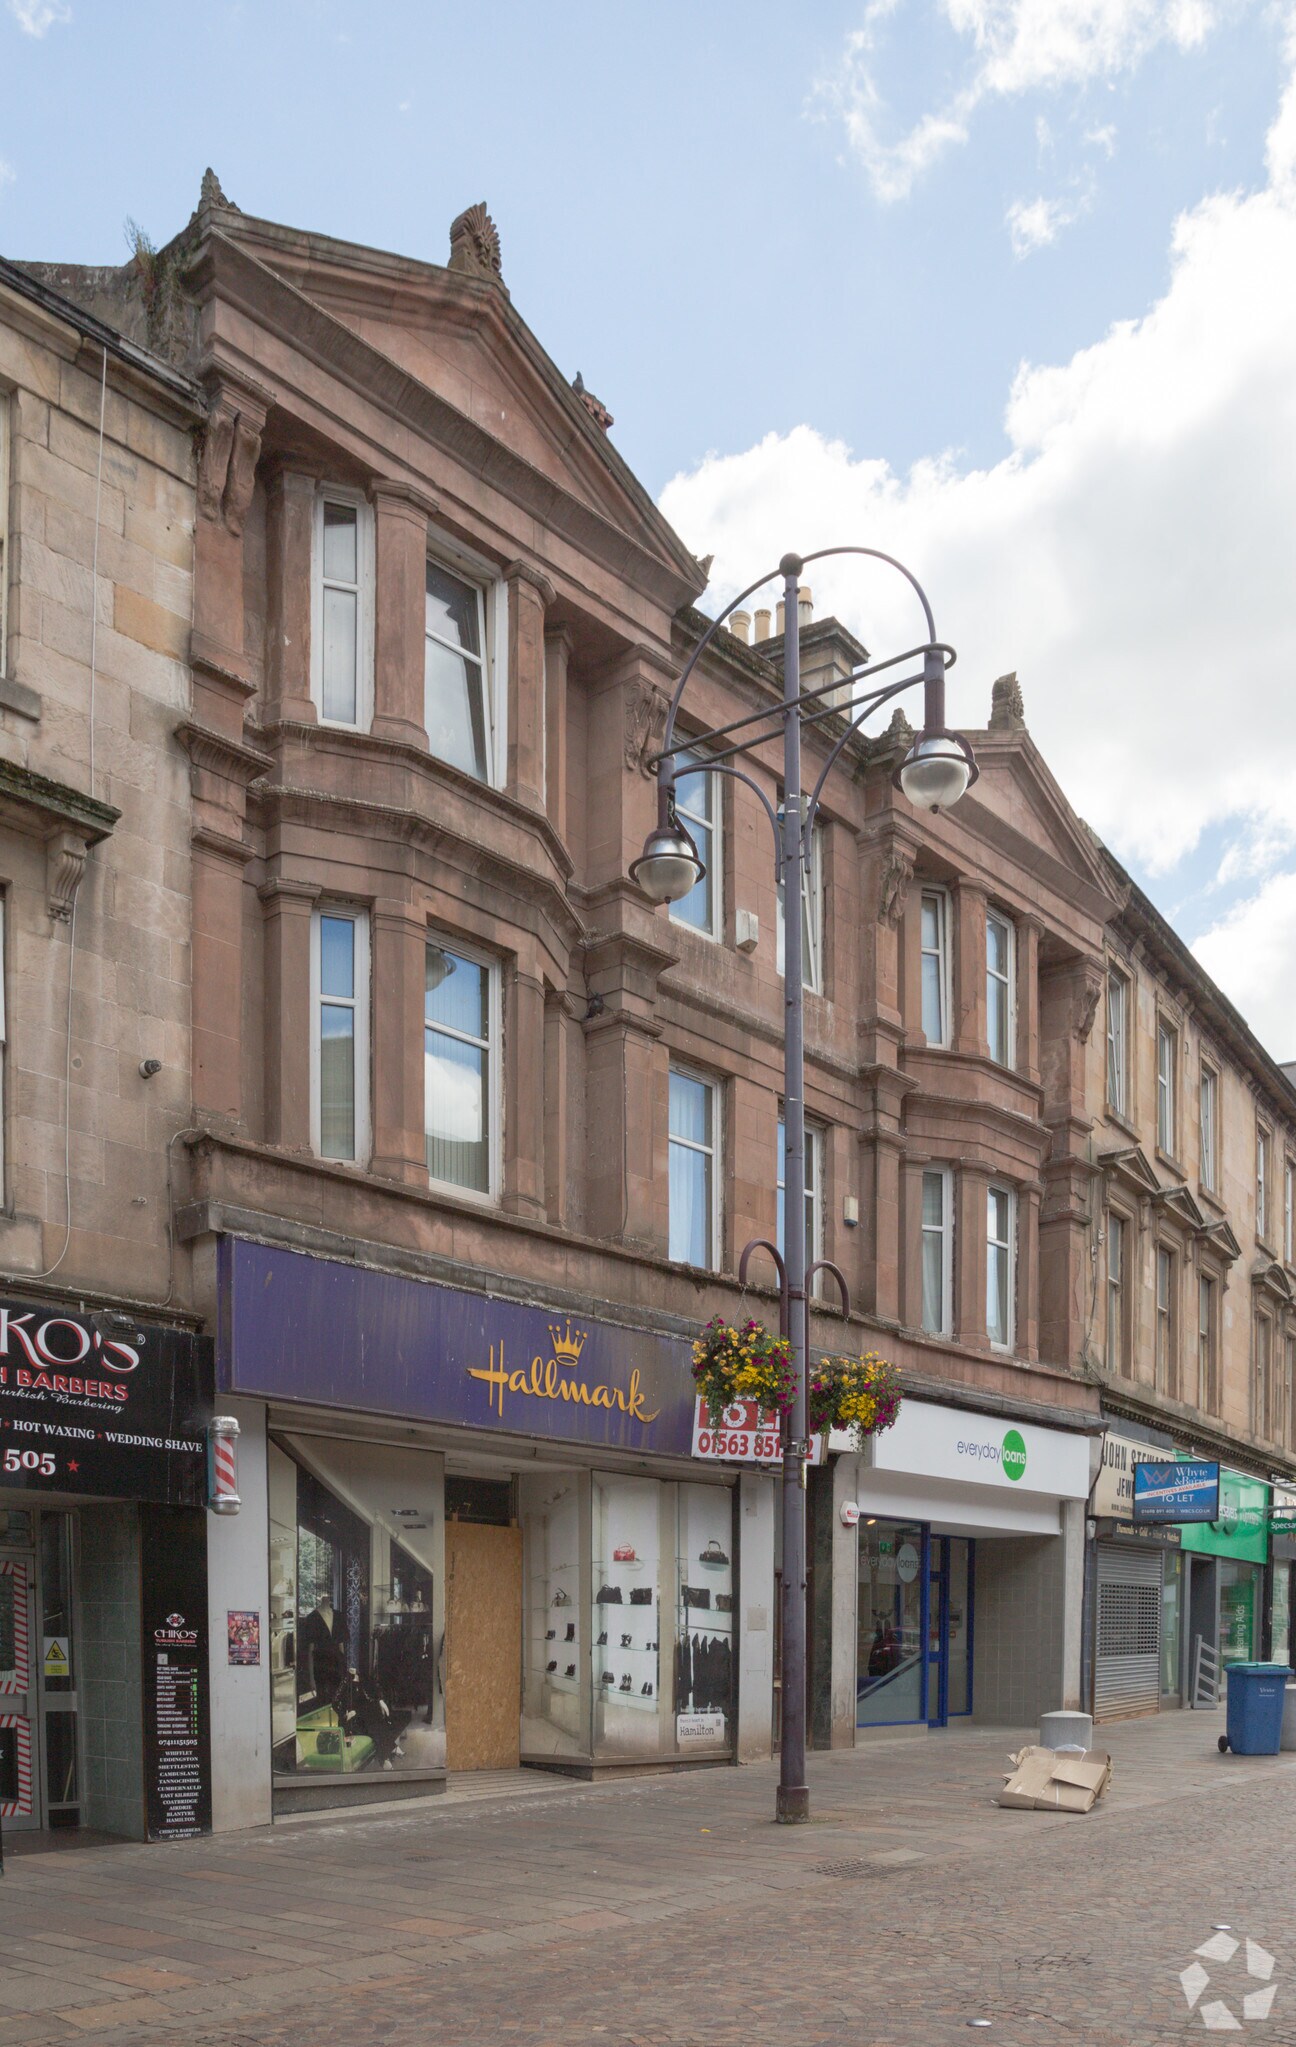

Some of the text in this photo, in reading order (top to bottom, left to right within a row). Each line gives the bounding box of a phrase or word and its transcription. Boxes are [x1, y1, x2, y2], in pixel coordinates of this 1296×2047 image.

[17, 1368, 129, 1401] BARBERS
[466, 1339, 661, 1423] Hallmark
[0, 1386, 124, 1414] urkish Barbering
[13, 1419, 41, 1433] HOT
[43, 1423, 96, 1440] WAXING
[105, 1431, 163, 1448] WEDDING
[164, 1439, 203, 1453] SHAVE
[698, 1432, 814, 1460] 01563 8512
[3, 1448, 56, 1476] 505
[957, 1439, 1026, 1465] everyday loans
[1103, 1440, 1127, 1471] JOHN
[1176, 1466, 1208, 1477] Whyte
[1177, 1494, 1194, 1503] LET
[154, 1629, 197, 1639] CHIKO'S
[679, 1724, 715, 1737] Hamilton
